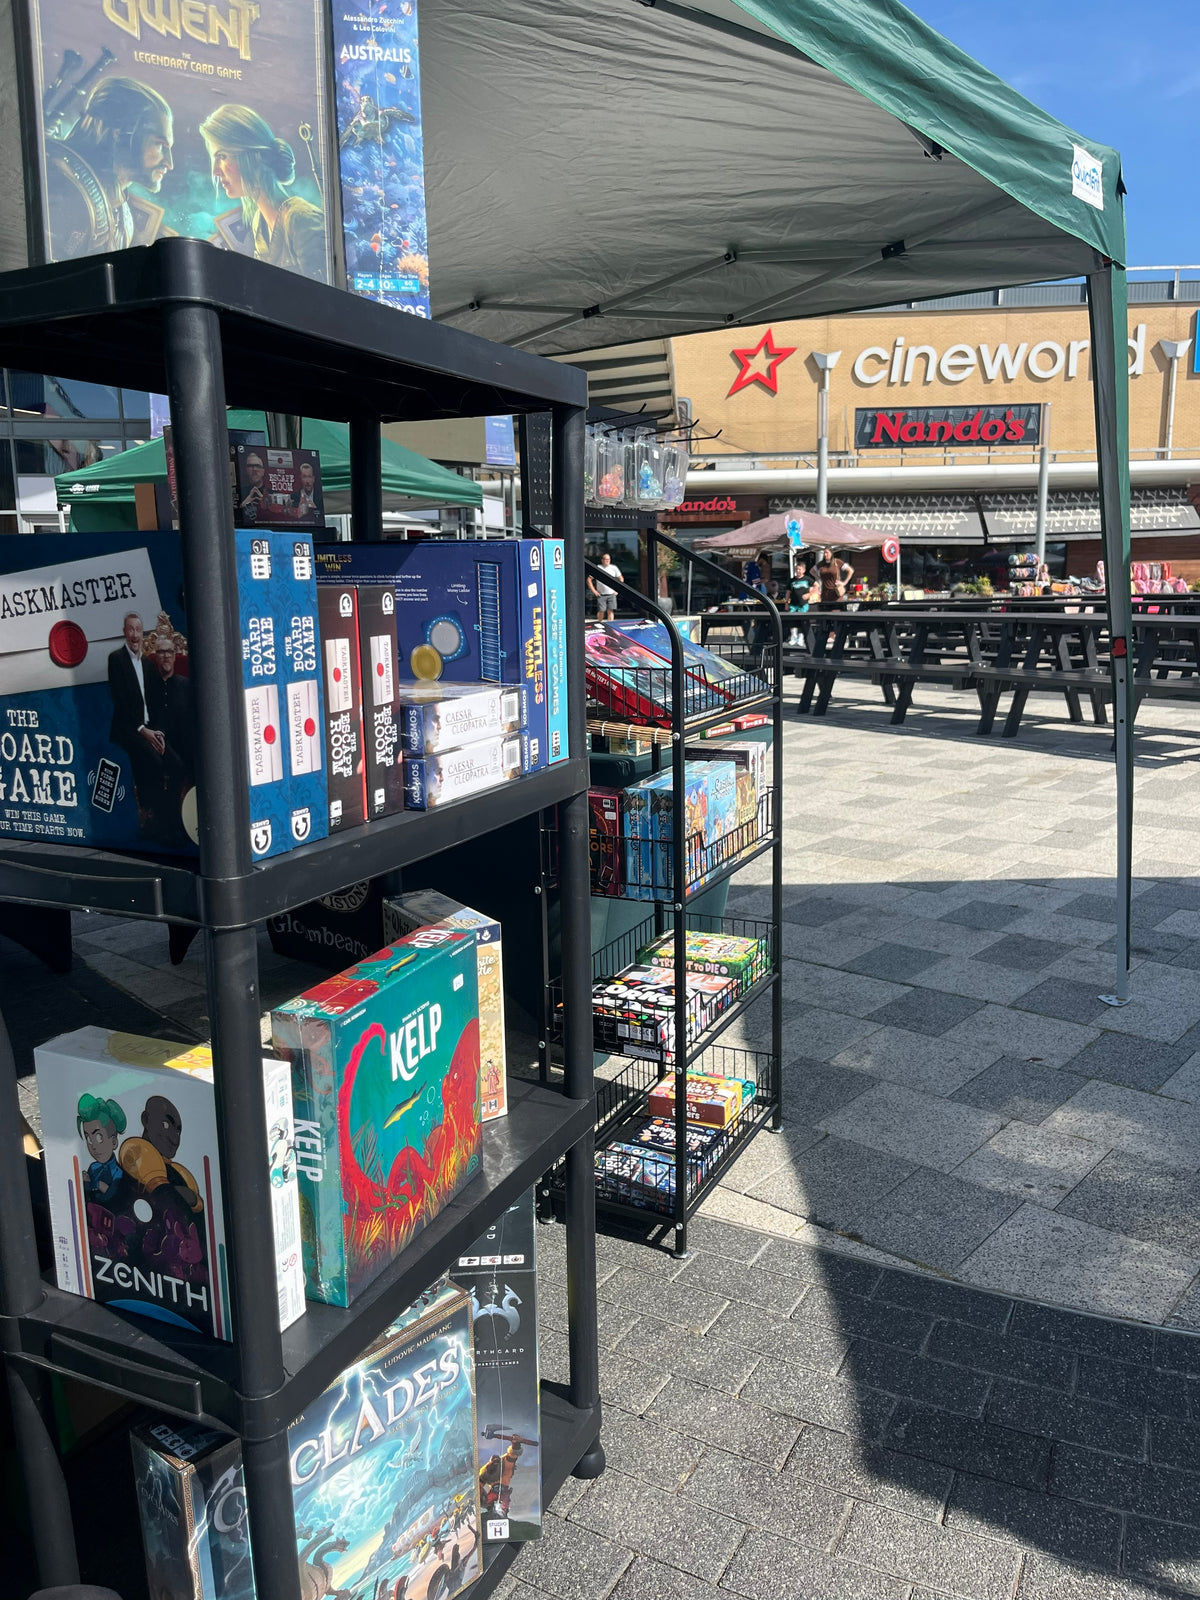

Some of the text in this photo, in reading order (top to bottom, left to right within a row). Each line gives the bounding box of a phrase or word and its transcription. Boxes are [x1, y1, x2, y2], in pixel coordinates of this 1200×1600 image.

[102, 0, 260, 61] GWENT
[343, 14, 404, 25] Alessandro Zucchini
[134, 50, 243, 81] LEGENDARY CARD GAME
[340, 45, 411, 63] AUSTRALIS
[356, 280, 375, 289] 2-4
[853, 323, 1147, 384] cineword
[870, 410, 1026, 444] Nando's
[269, 473, 295, 483] ESCAPE
[271, 481, 294, 492] ROOM
[325, 563, 341, 572] WIN
[0, 572, 137, 620] ASKMASTER
[550, 589, 558, 641] HOUSE
[242, 638, 250, 660] THE
[249, 617, 263, 677] BOARD
[260, 617, 276, 676] GAME
[284, 636, 292, 657] THE
[291, 616, 304, 672] BOARD
[301, 616, 316, 671] GAME
[525, 638, 534, 679] WIN
[533, 607, 544, 705] LIMITLESS
[551, 663, 560, 716] GAMES
[7, 709, 39, 728] THE
[292, 692, 304, 766] TASKMASTER
[383, 705, 394, 767] ESCAPE
[409, 709, 418, 751] KOSMOS
[445, 708, 473, 723] CAESAR
[452, 717, 488, 735] CLEOPATRA
[0, 732, 74, 765] OARD
[251, 698, 264, 776] TASKMASTER
[330, 719, 344, 775] ROOM
[341, 712, 353, 778] ESCAPE
[373, 712, 385, 765] ROOM
[411, 763, 422, 804] KOSMOS
[448, 758, 474, 775] CAESAR
[454, 767, 489, 786] CLEOPATRA
[4, 809, 20, 819] WIN
[21, 810, 41, 821] THIS
[12, 822, 34, 833] TIME
[35, 824, 65, 836] STARTS
[67, 827, 86, 839] NOW.
[409, 929, 455, 949] KELP
[658, 957, 675, 969] TRY
[694, 963, 704, 972] TO
[705, 962, 720, 974] DIE
[390, 1003, 442, 1082] KELP
[294, 1118, 323, 1182] KELP
[94, 1255, 208, 1312] ZENITH
[384, 1322, 453, 1369] LUDOVIC MAUBLANC
[476, 1348, 525, 1356] RTHGARD
[494, 1527, 503, 1537] H
